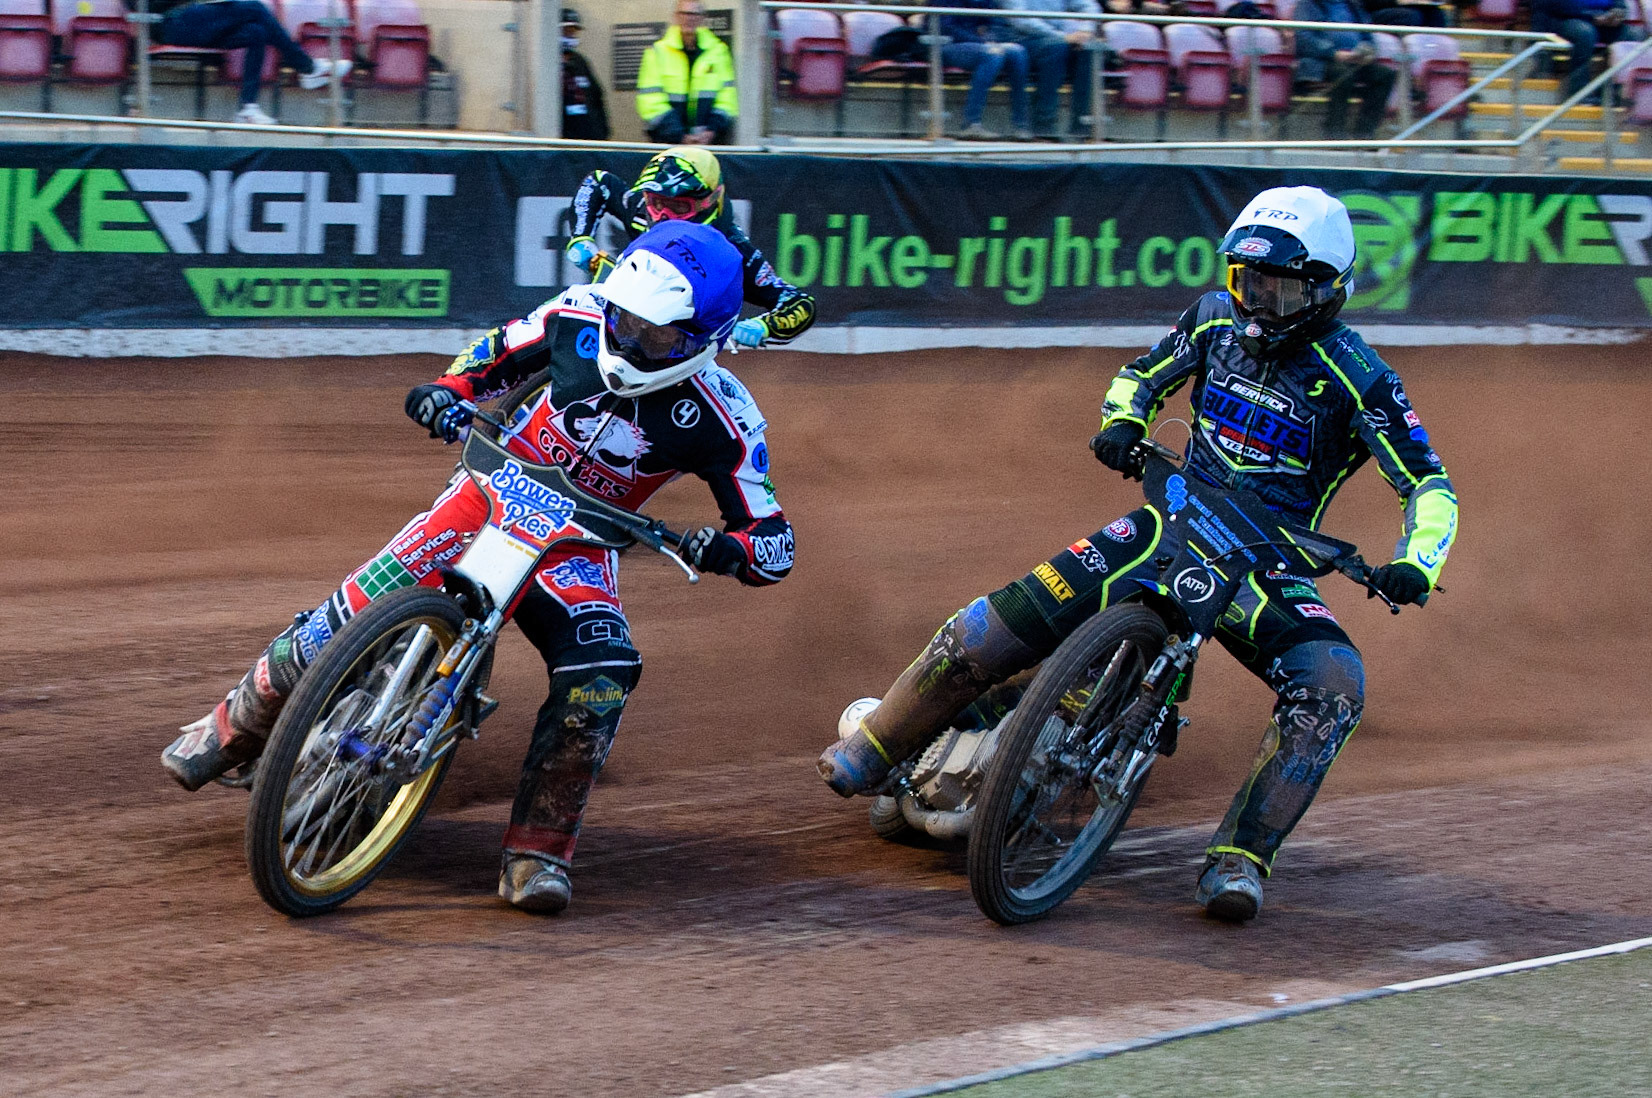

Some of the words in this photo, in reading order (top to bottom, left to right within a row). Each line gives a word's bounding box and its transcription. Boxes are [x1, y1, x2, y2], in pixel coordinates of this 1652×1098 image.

[1253, 206, 1300, 222] FRP
[665, 238, 707, 280] FRP
[212, 277, 442, 309] MOTORBIKE
[1229, 382, 1289, 413] BERWICK
[1306, 379, 1330, 397] 5
[1219, 425, 1274, 454] SPEWAY
[538, 427, 633, 499] COLTS
[503, 500, 551, 539] Pies
[400, 527, 458, 568] Services
[1146, 705, 1169, 747] CAR
